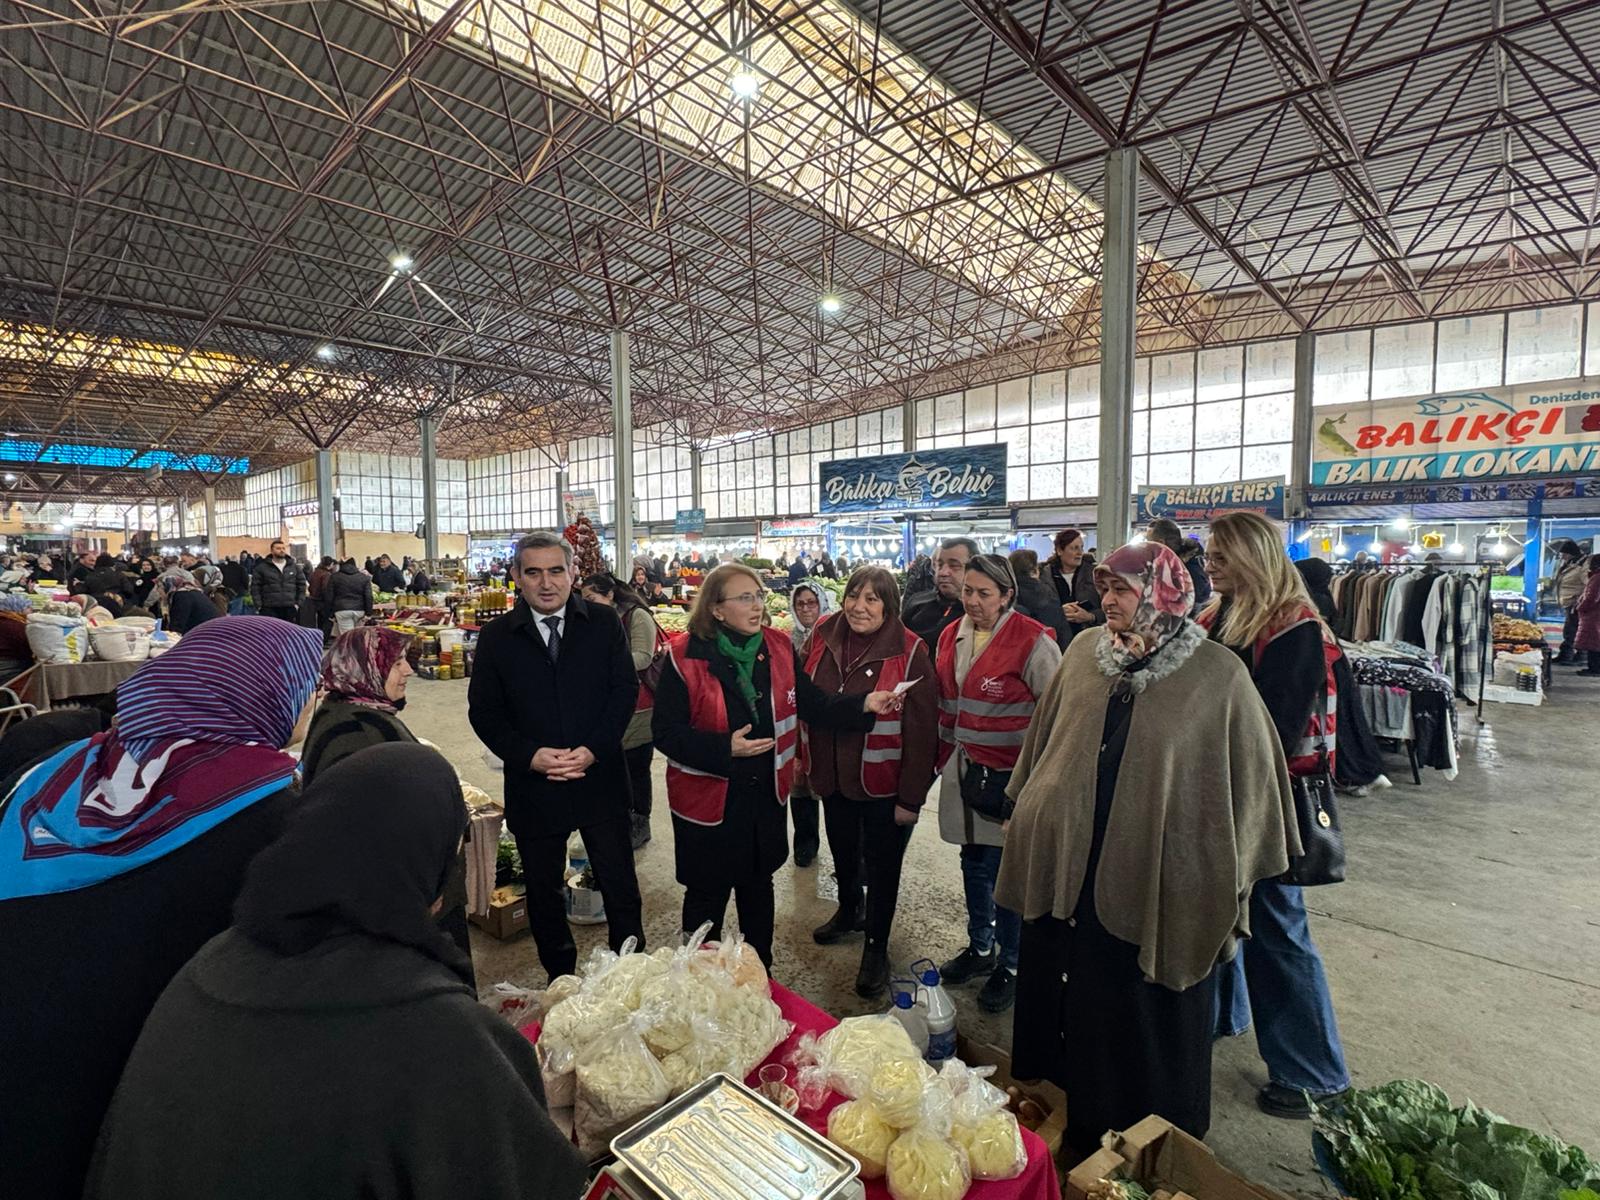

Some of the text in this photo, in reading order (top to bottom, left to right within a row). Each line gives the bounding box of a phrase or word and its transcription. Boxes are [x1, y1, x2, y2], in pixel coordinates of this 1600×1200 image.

[1529, 390, 1600, 405] Denizden
[1356, 407, 1563, 449] BALIKÇI
[825, 463, 996, 505] Balıkçı Behiç
[1324, 456, 1437, 486] BALIK
[1231, 481, 1279, 503] ENES
[1311, 489, 1398, 503] BALIKÇI ENES
